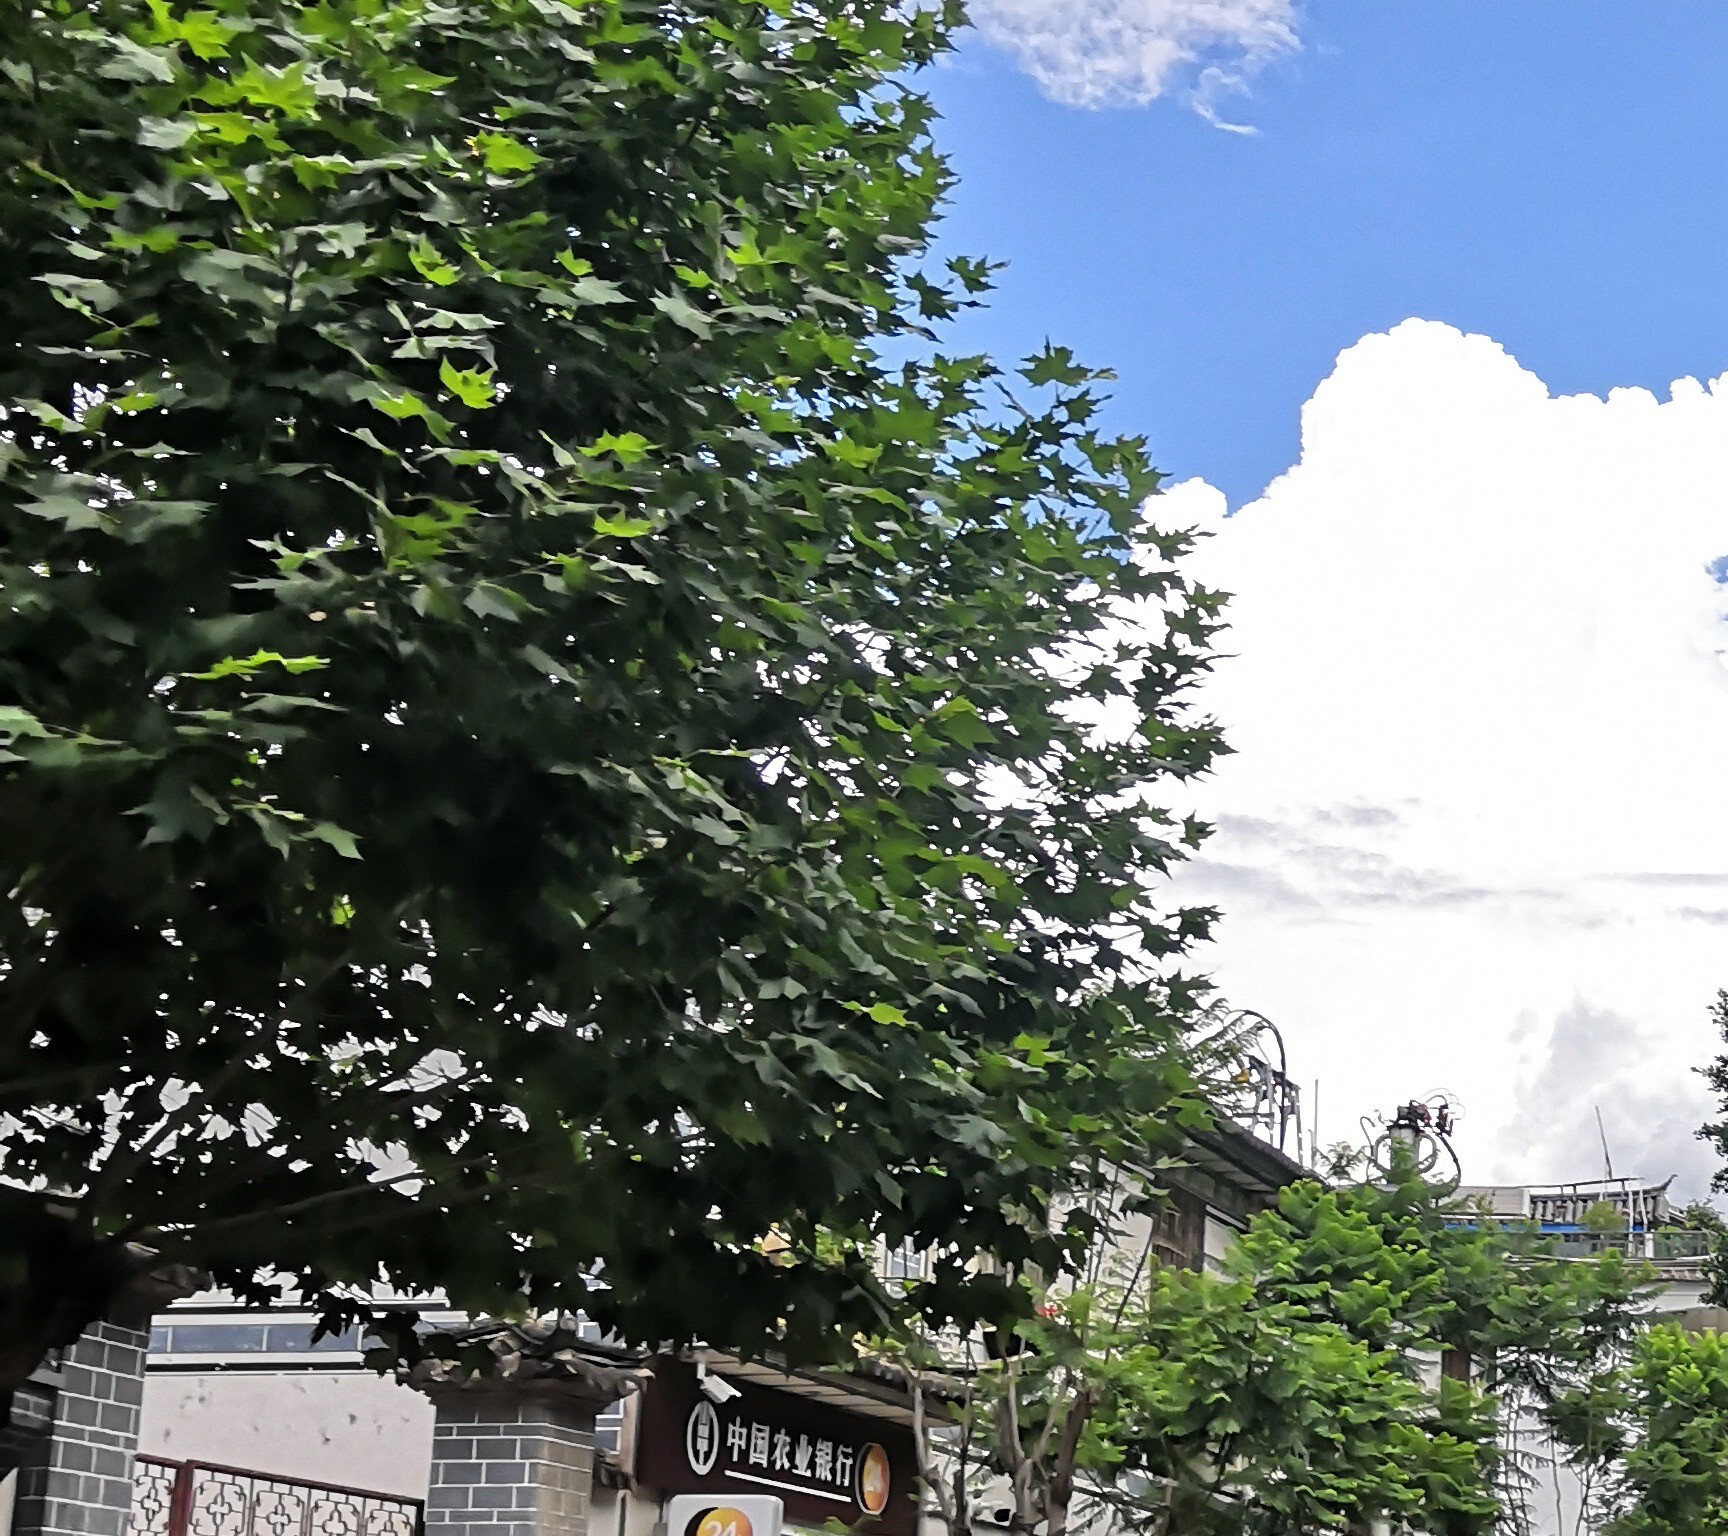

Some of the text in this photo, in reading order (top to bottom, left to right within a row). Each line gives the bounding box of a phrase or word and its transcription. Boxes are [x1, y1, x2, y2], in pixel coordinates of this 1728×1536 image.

[726, 1415, 853, 1487] 中国农业银行
